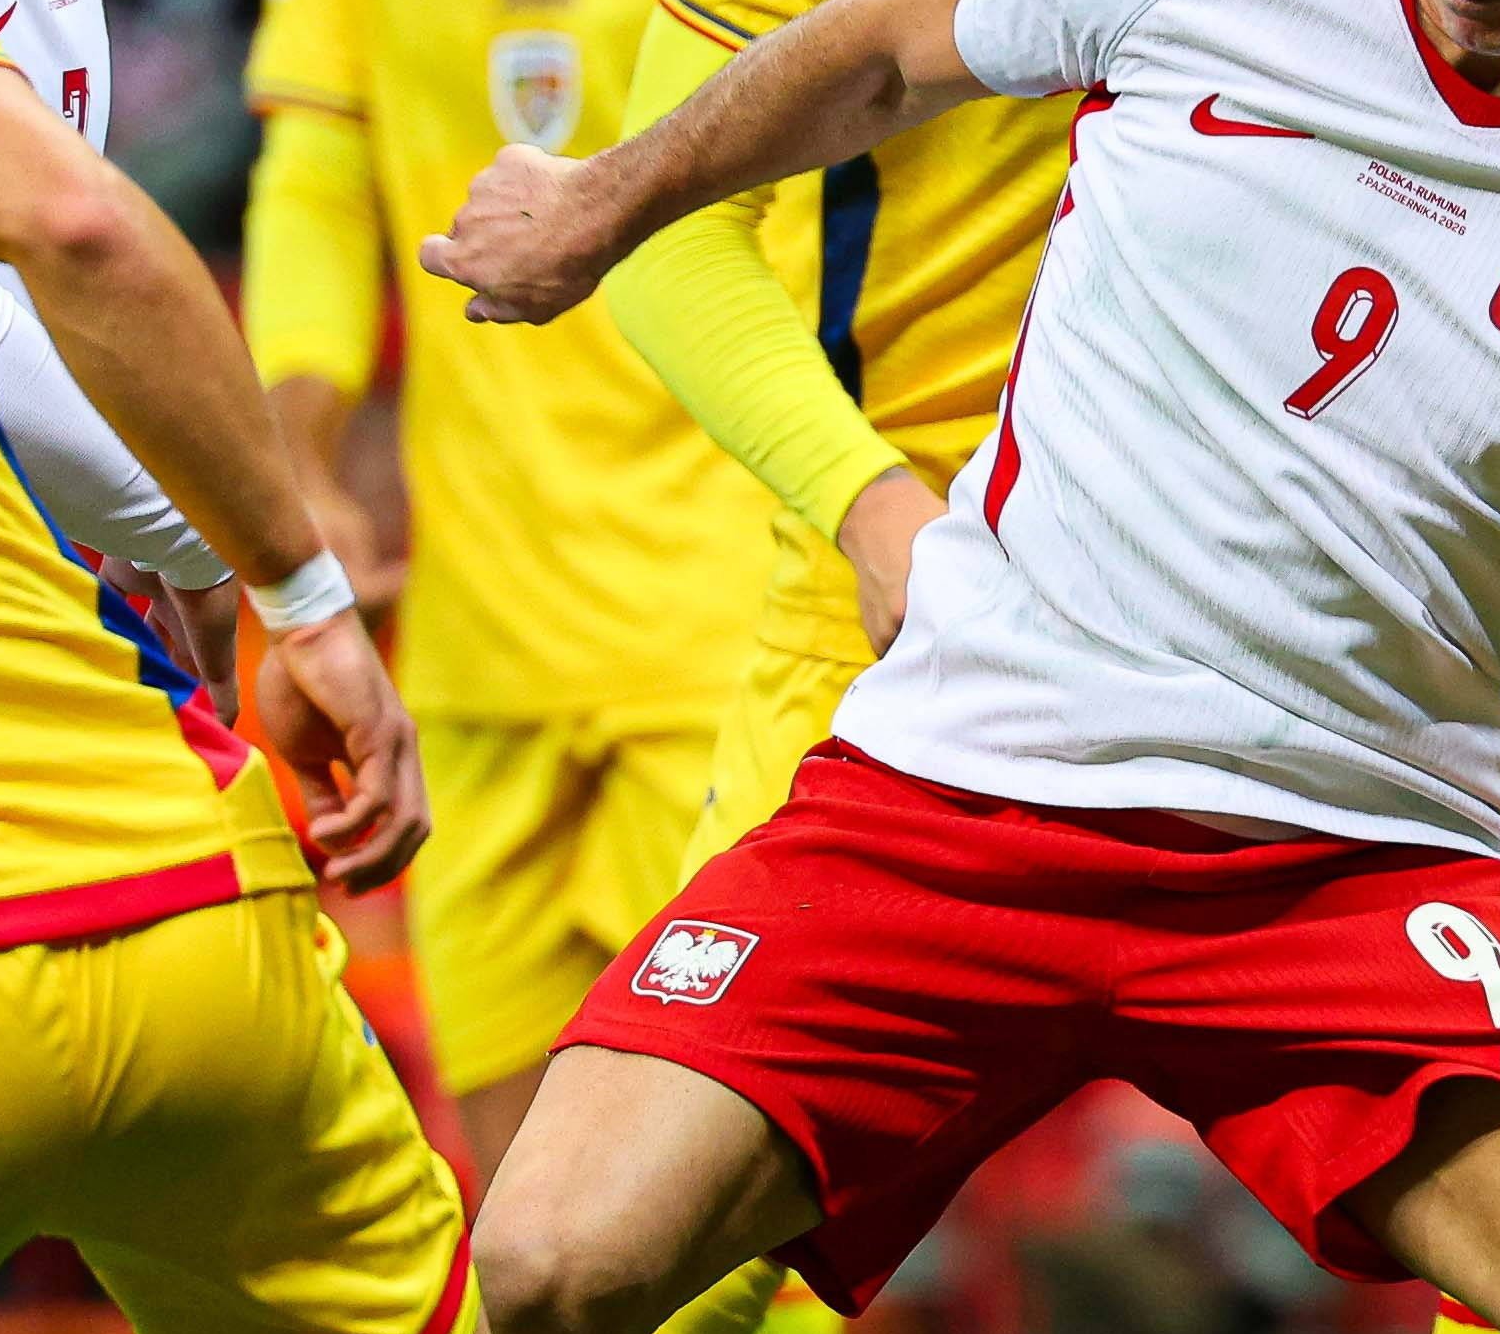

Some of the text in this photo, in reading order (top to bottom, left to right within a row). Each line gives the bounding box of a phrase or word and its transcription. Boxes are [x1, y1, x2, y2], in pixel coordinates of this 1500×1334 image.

[1356, 172, 1366, 184] 2
[1365, 176, 1437, 223] PAŹDZIERNIKA
[1368, 160, 1468, 220] POLSKA-RUMUNIA
[1283, 266, 1400, 422] 9
